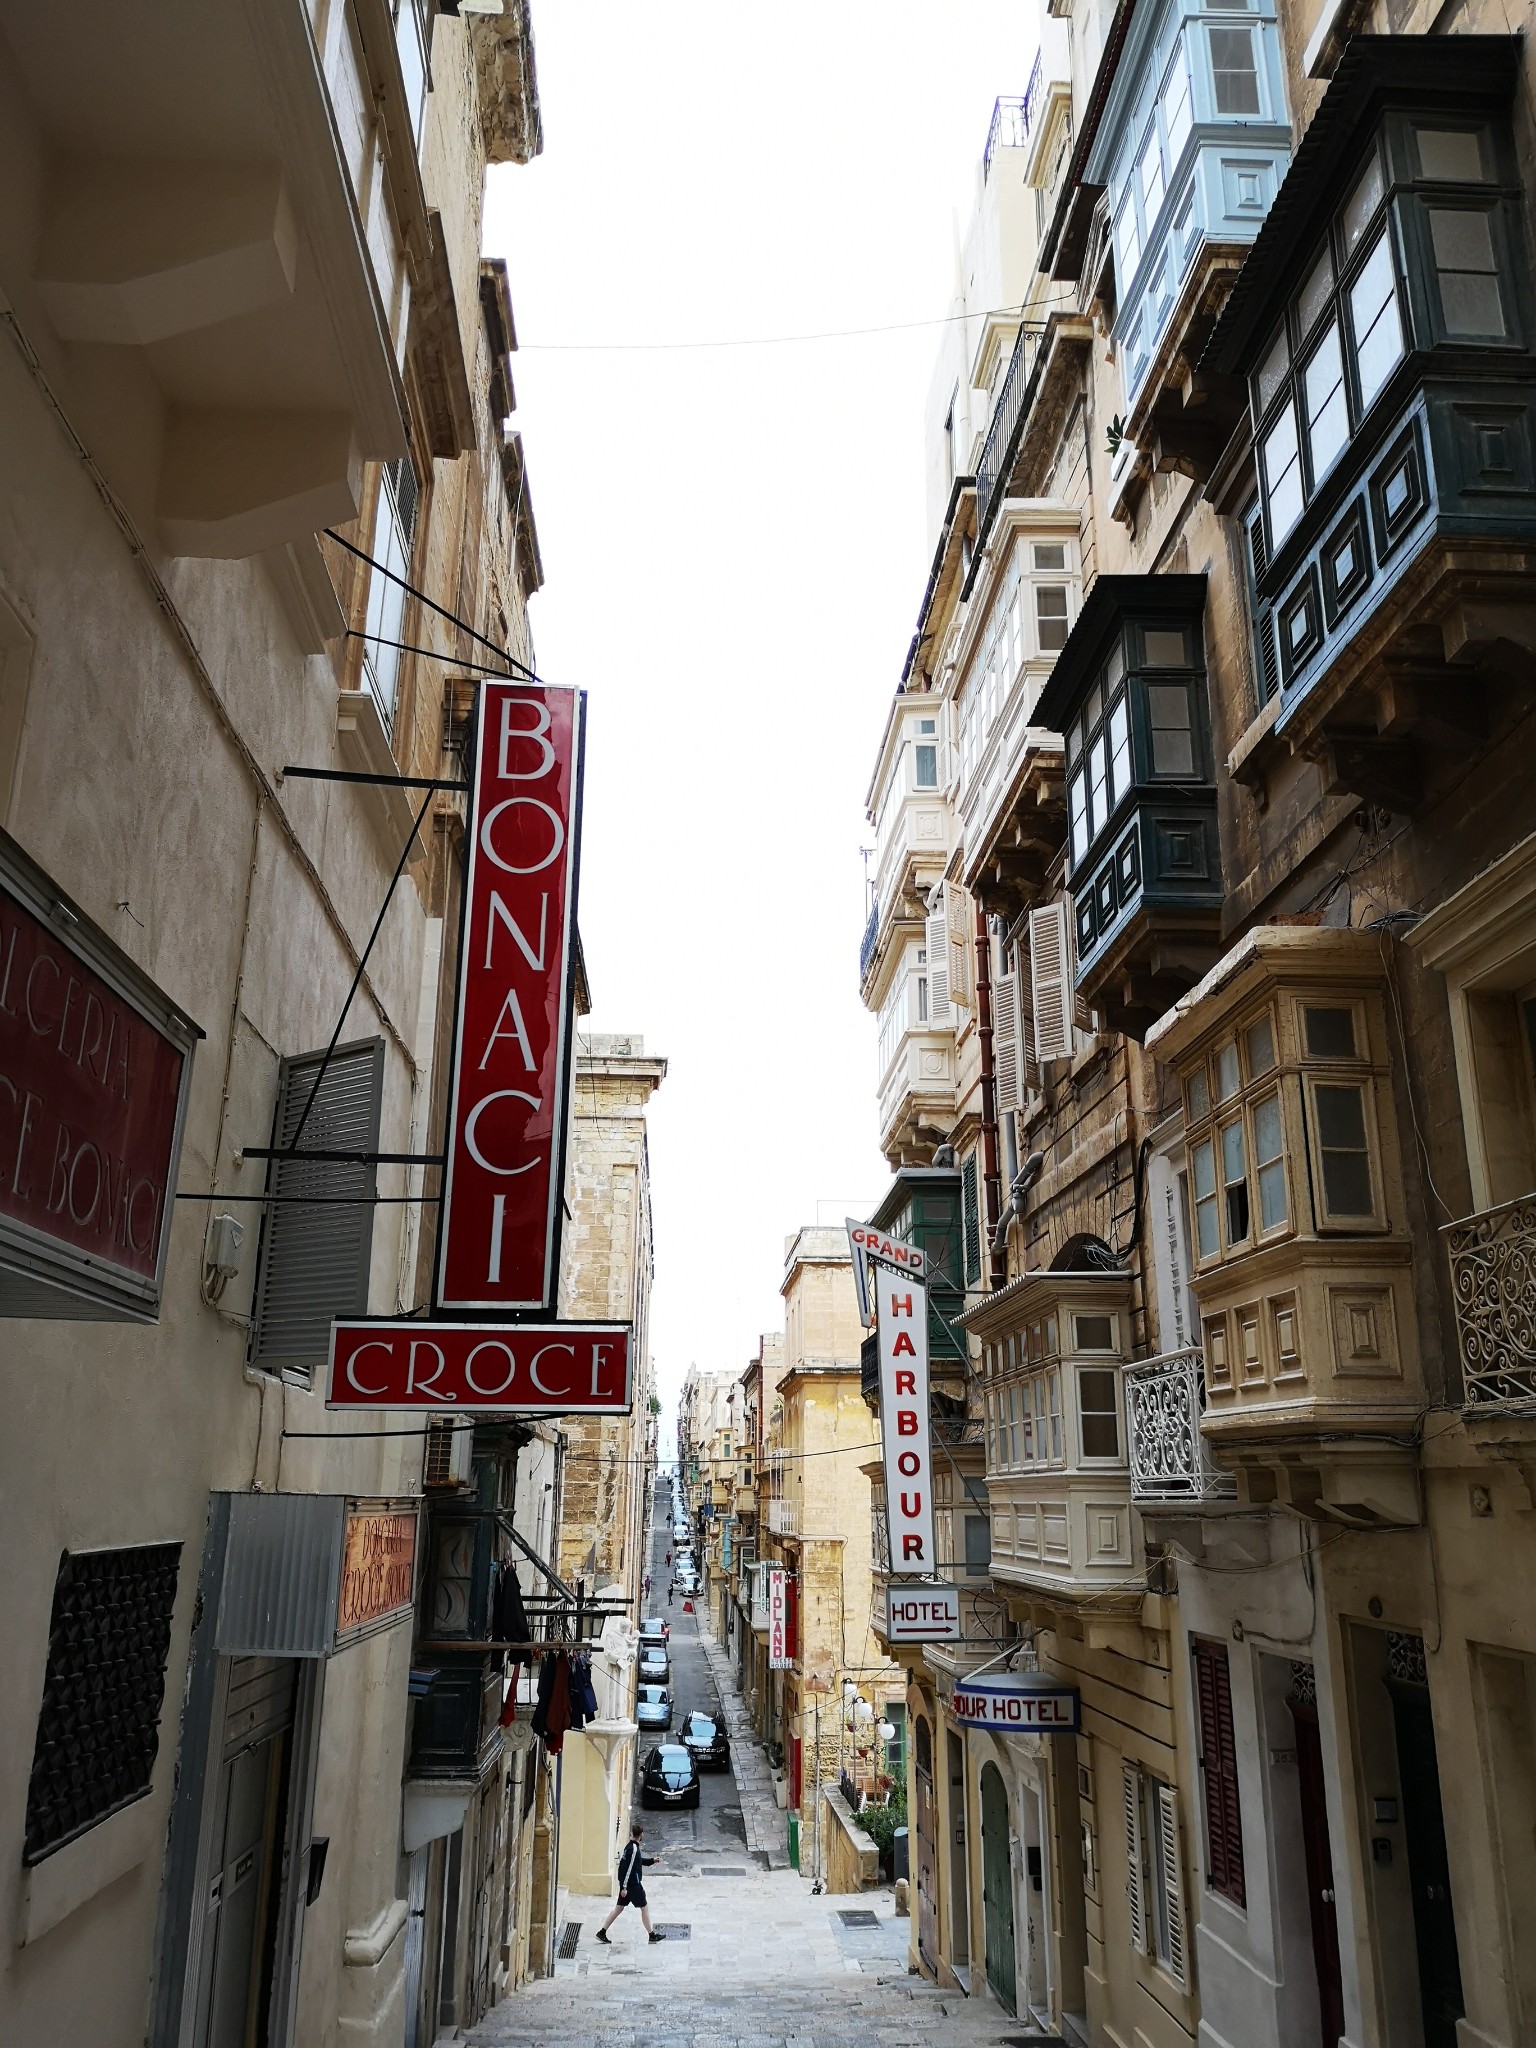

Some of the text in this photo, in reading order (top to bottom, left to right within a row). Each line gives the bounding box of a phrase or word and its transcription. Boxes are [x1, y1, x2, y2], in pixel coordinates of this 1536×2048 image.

[0, 924, 131, 1103] LCERIA
[465, 697, 566, 1284] BONACI
[46, 1121, 164, 1262] BONACI
[852, 1228, 923, 1268] GRAND
[346, 1340, 614, 1401] CROCE
[891, 1293, 925, 1561] HARBOUR
[773, 1572, 783, 1659] MIDLAND
[892, 1602, 957, 1622] HOTEL
[992, 1698, 1069, 1722] HOTEL
